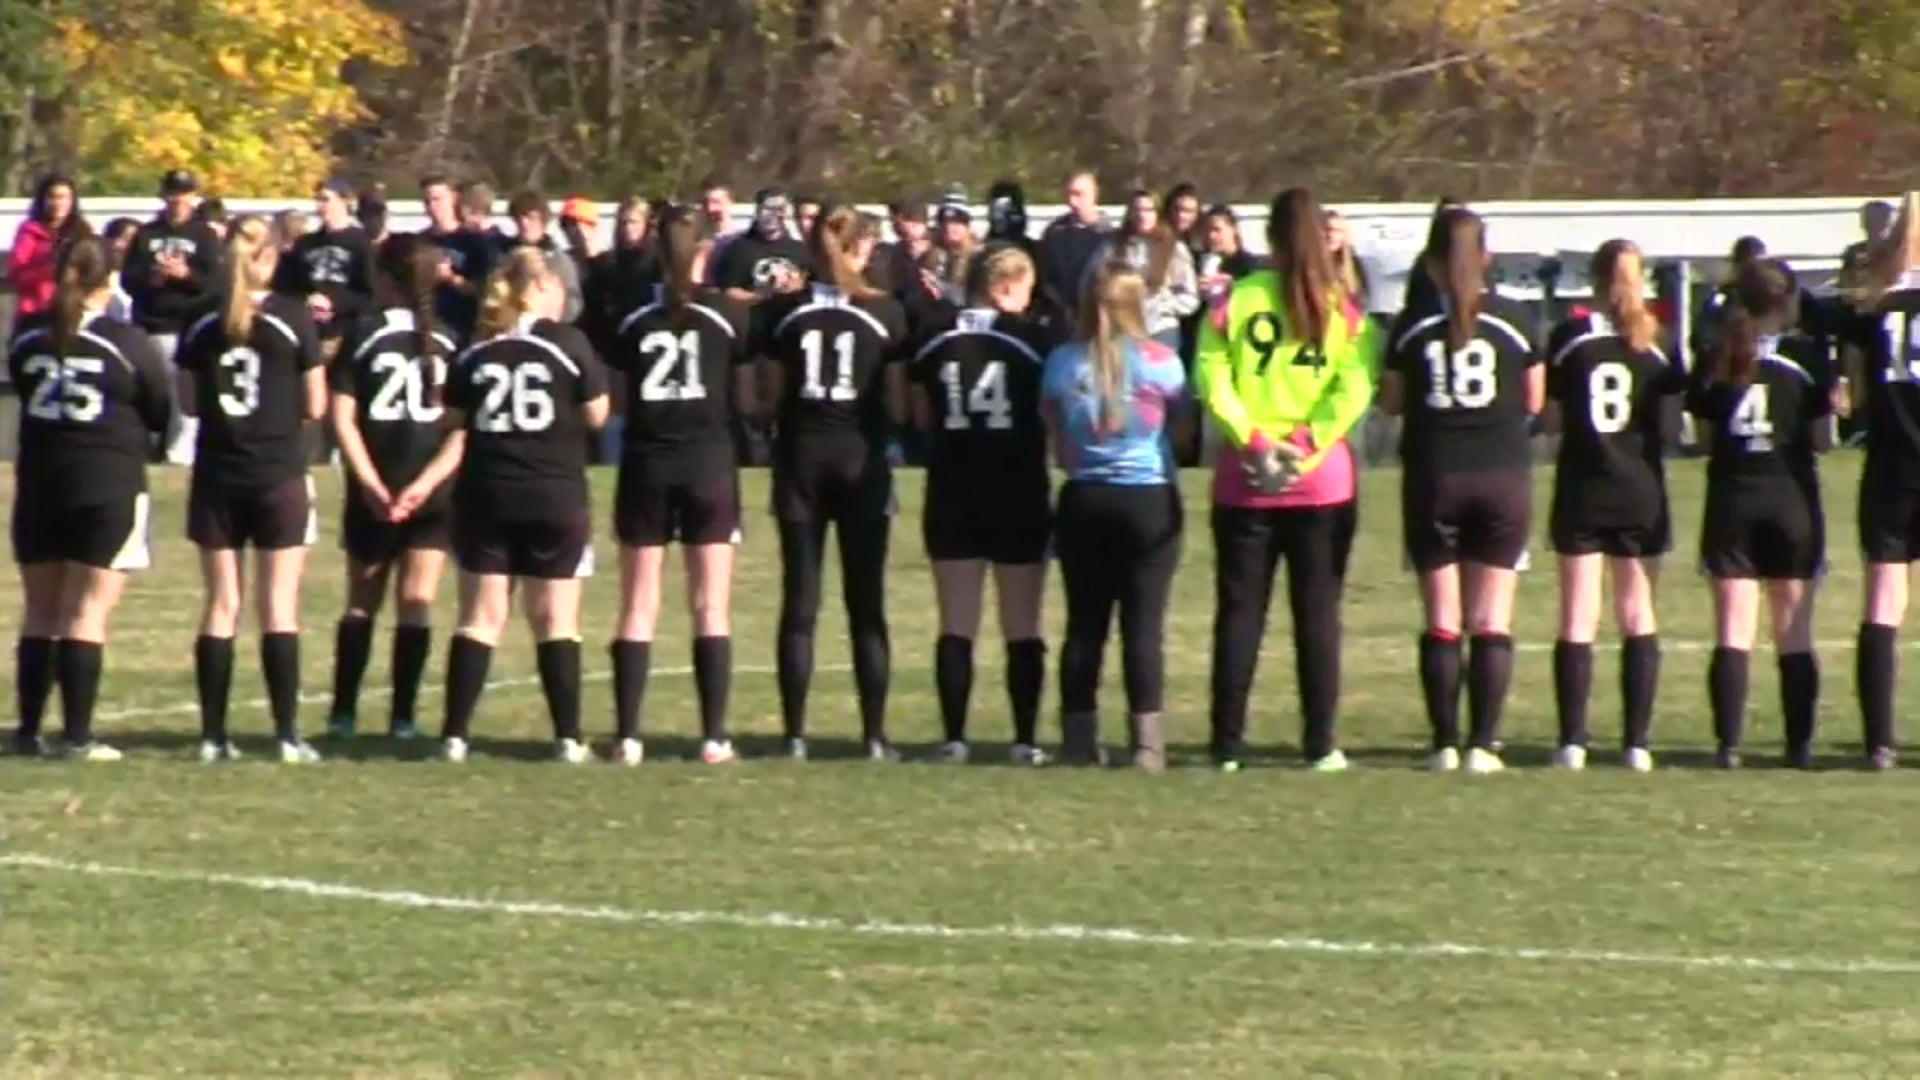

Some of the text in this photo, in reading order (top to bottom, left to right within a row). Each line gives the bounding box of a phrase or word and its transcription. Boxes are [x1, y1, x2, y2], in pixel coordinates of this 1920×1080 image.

[22, 354, 105, 424] 25
[218, 347, 261, 417] 3
[472, 361, 556, 433] 26
[639, 330, 706, 402] 21
[799, 329, 859, 401] 11
[940, 361, 1012, 430] 14
[1423, 340, 1498, 409] 18
[1589, 363, 1633, 434] 8
[1728, 384, 1774, 453] 4
